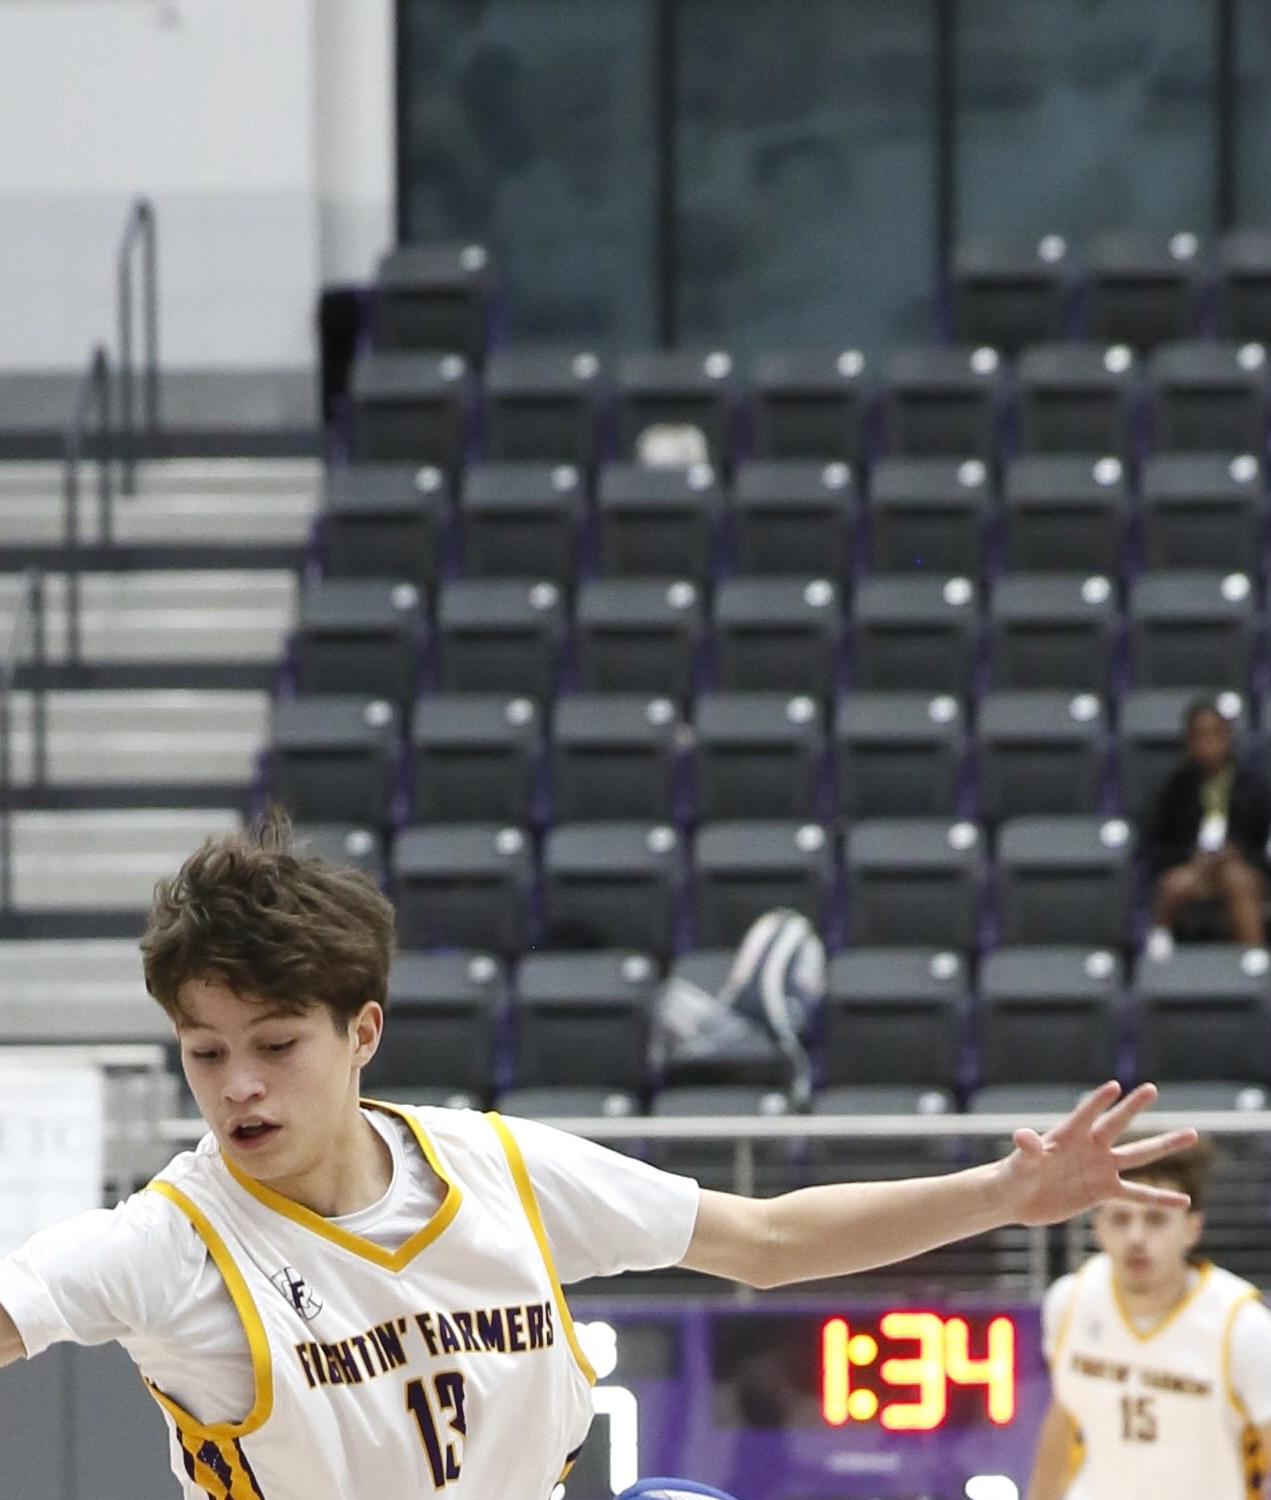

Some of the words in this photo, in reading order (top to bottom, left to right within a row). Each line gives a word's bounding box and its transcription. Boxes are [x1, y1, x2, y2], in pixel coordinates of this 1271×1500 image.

[293, 1315, 409, 1390] FIGHTIN'
[414, 1300, 554, 1358] FARMERS
[822, 1310, 1017, 1430] 1:34
[404, 1369, 467, 1490] 13
[1120, 1396, 1158, 1442] 15
